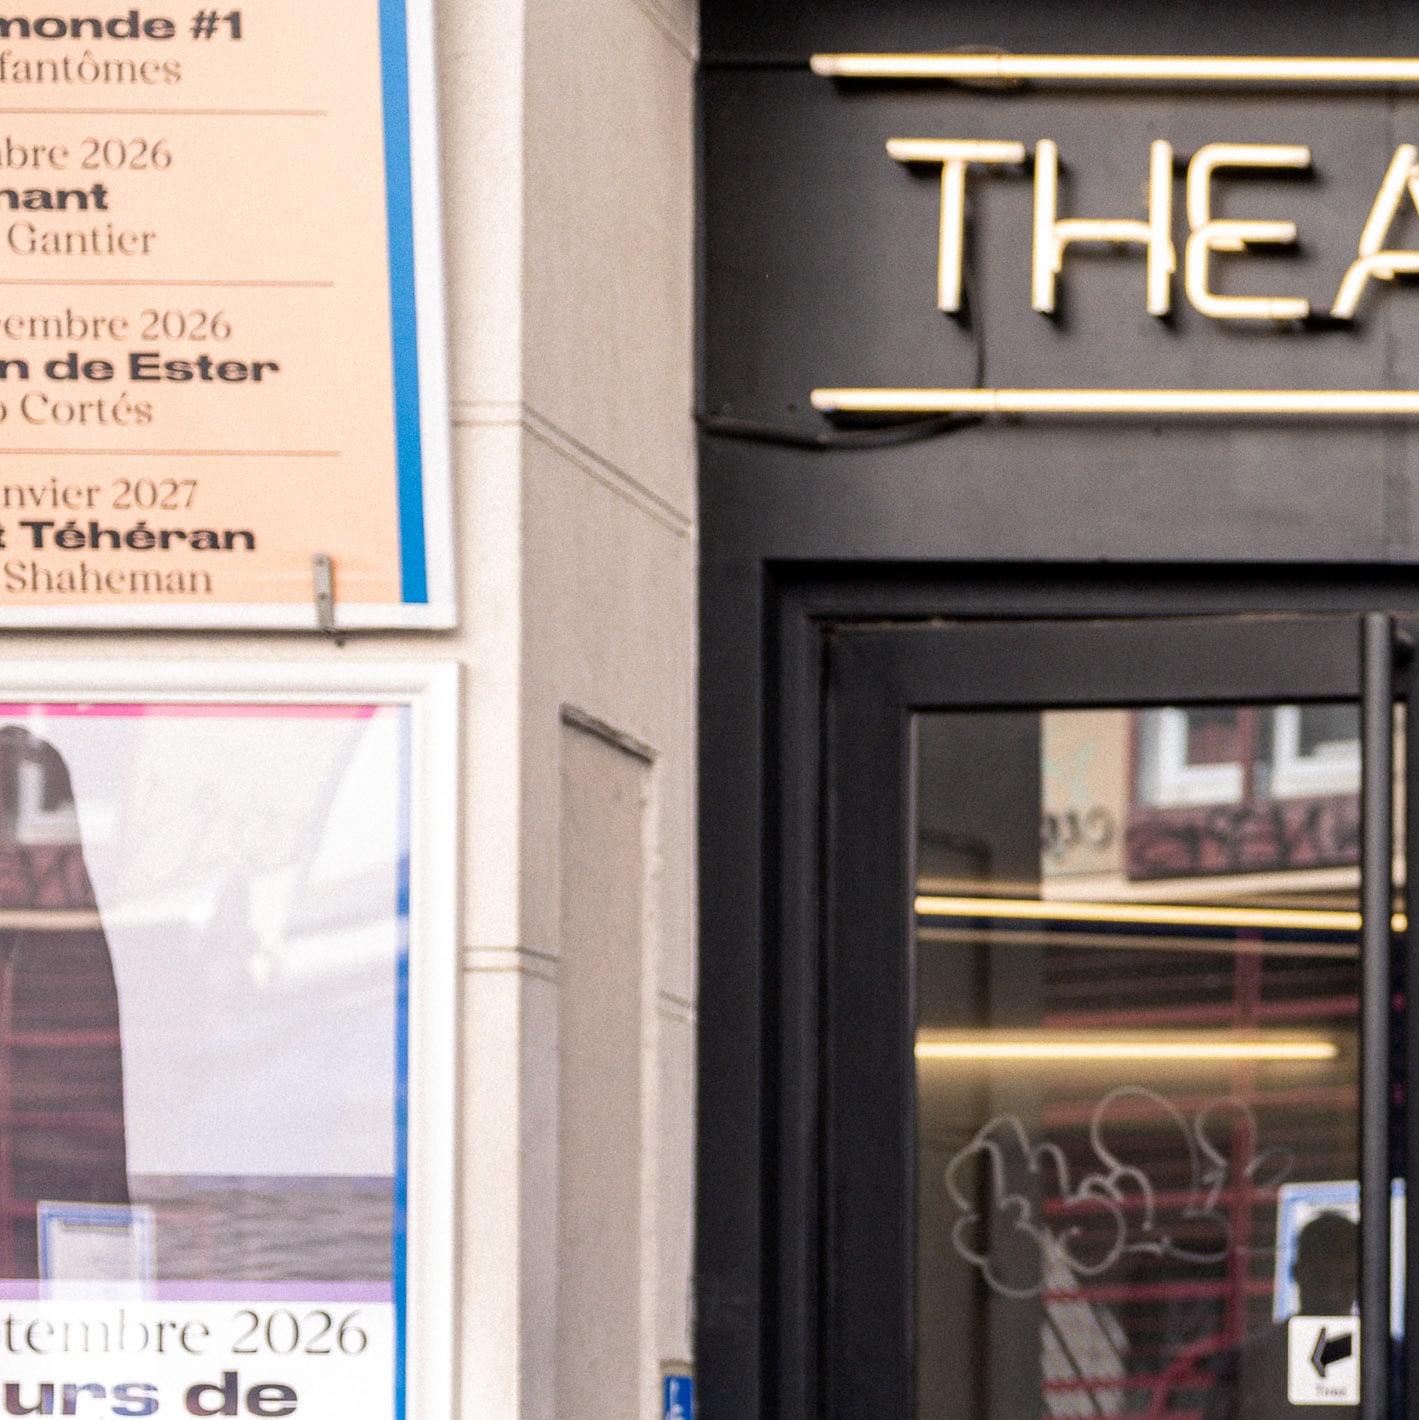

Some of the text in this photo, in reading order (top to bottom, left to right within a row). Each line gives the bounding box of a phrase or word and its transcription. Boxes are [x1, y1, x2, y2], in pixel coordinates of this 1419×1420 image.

[190, 9, 243, 41] #1
[0, 49, 182, 84] fantômes
[0, 136, 173, 170] bre 2026
[7, 221, 157, 256] Gantier
[0, 307, 232, 341] embre 2026
[44, 351, 115, 383] de
[128, 352, 281, 384] Ester
[20, 391, 153, 426] Cortés
[3, 477, 198, 511] nvier 2027
[18, 519, 257, 552] Téhéran
[4, 560, 213, 595] Shaheman
[2, 1308, 369, 1356] tembre 2026
[4, 1370, 298, 1418] urs de
